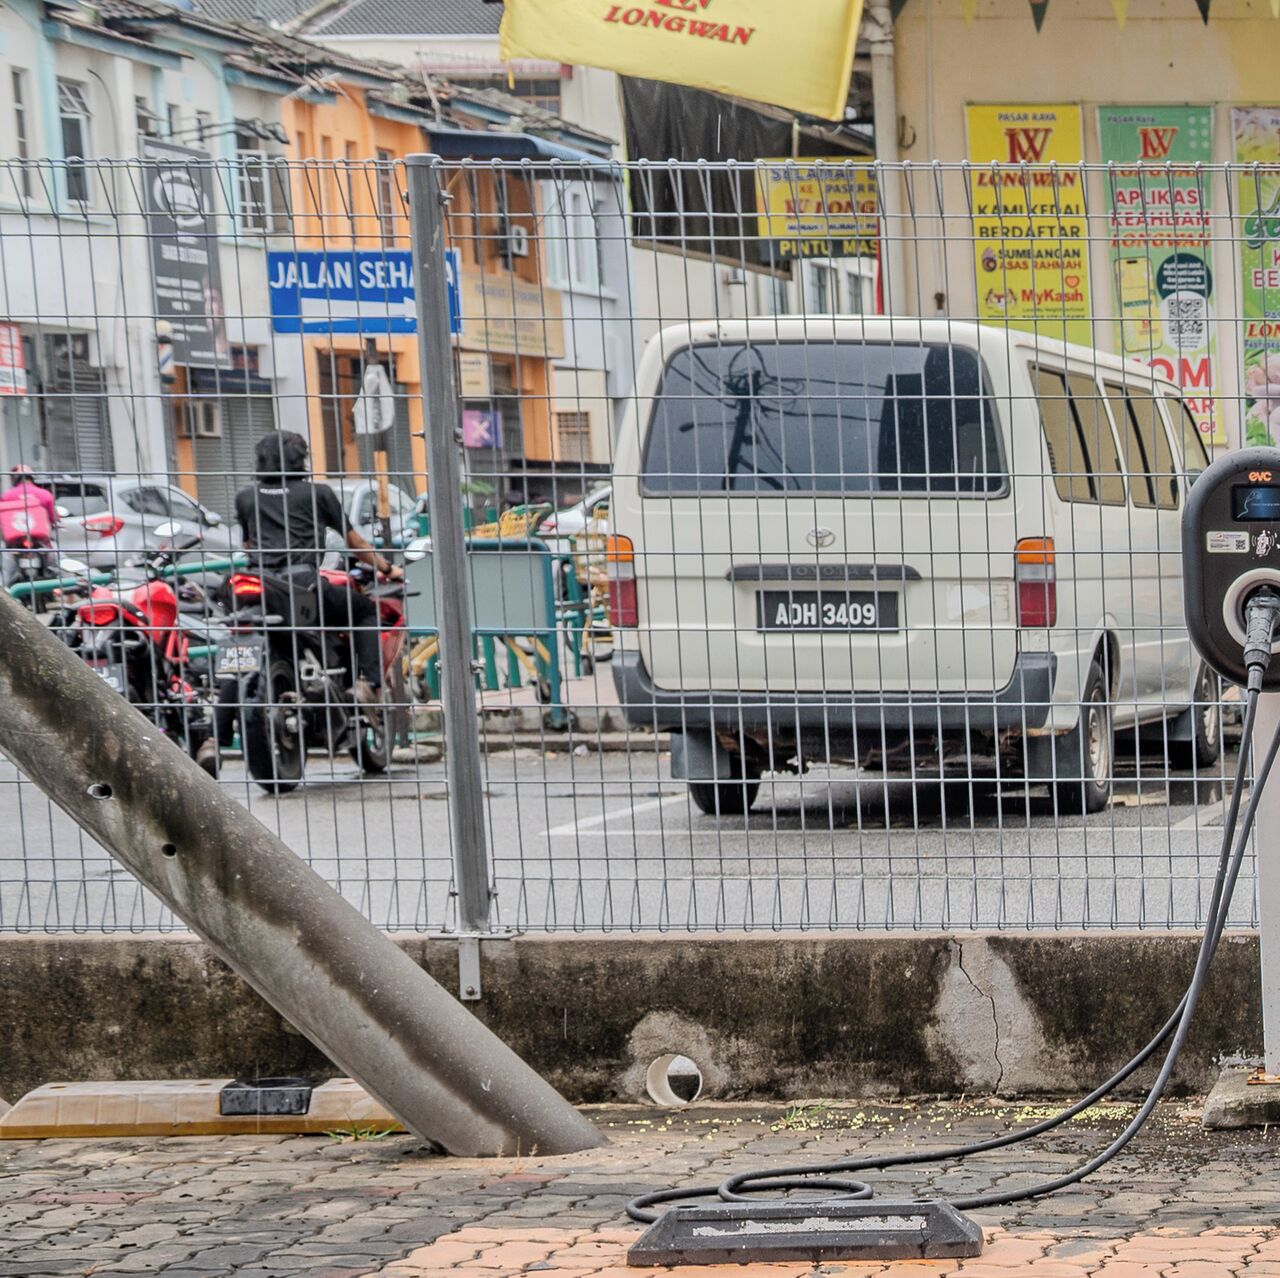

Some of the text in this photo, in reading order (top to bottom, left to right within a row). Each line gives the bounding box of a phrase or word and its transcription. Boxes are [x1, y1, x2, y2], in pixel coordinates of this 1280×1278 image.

[603, 5, 756, 45] LONGWAN
[998, 113, 1029, 121] PASAR
[977, 172, 1077, 187] LONGWAN
[1110, 210, 1211, 227] KEAHLIAN
[979, 226, 1081, 239] BERDAFTAR
[1110, 232, 1211, 248] LONGWAN
[780, 240, 832, 256] PINTU
[998, 248, 1081, 259] SUMBANGAN
[1000, 260, 1082, 270] ASAS RAHMAH
[269, 261, 354, 289] JALAN
[1021, 288, 1084, 305] MyKasih
[1248, 471, 1273, 483] evc
[775, 602, 876, 626] ADH 3409
